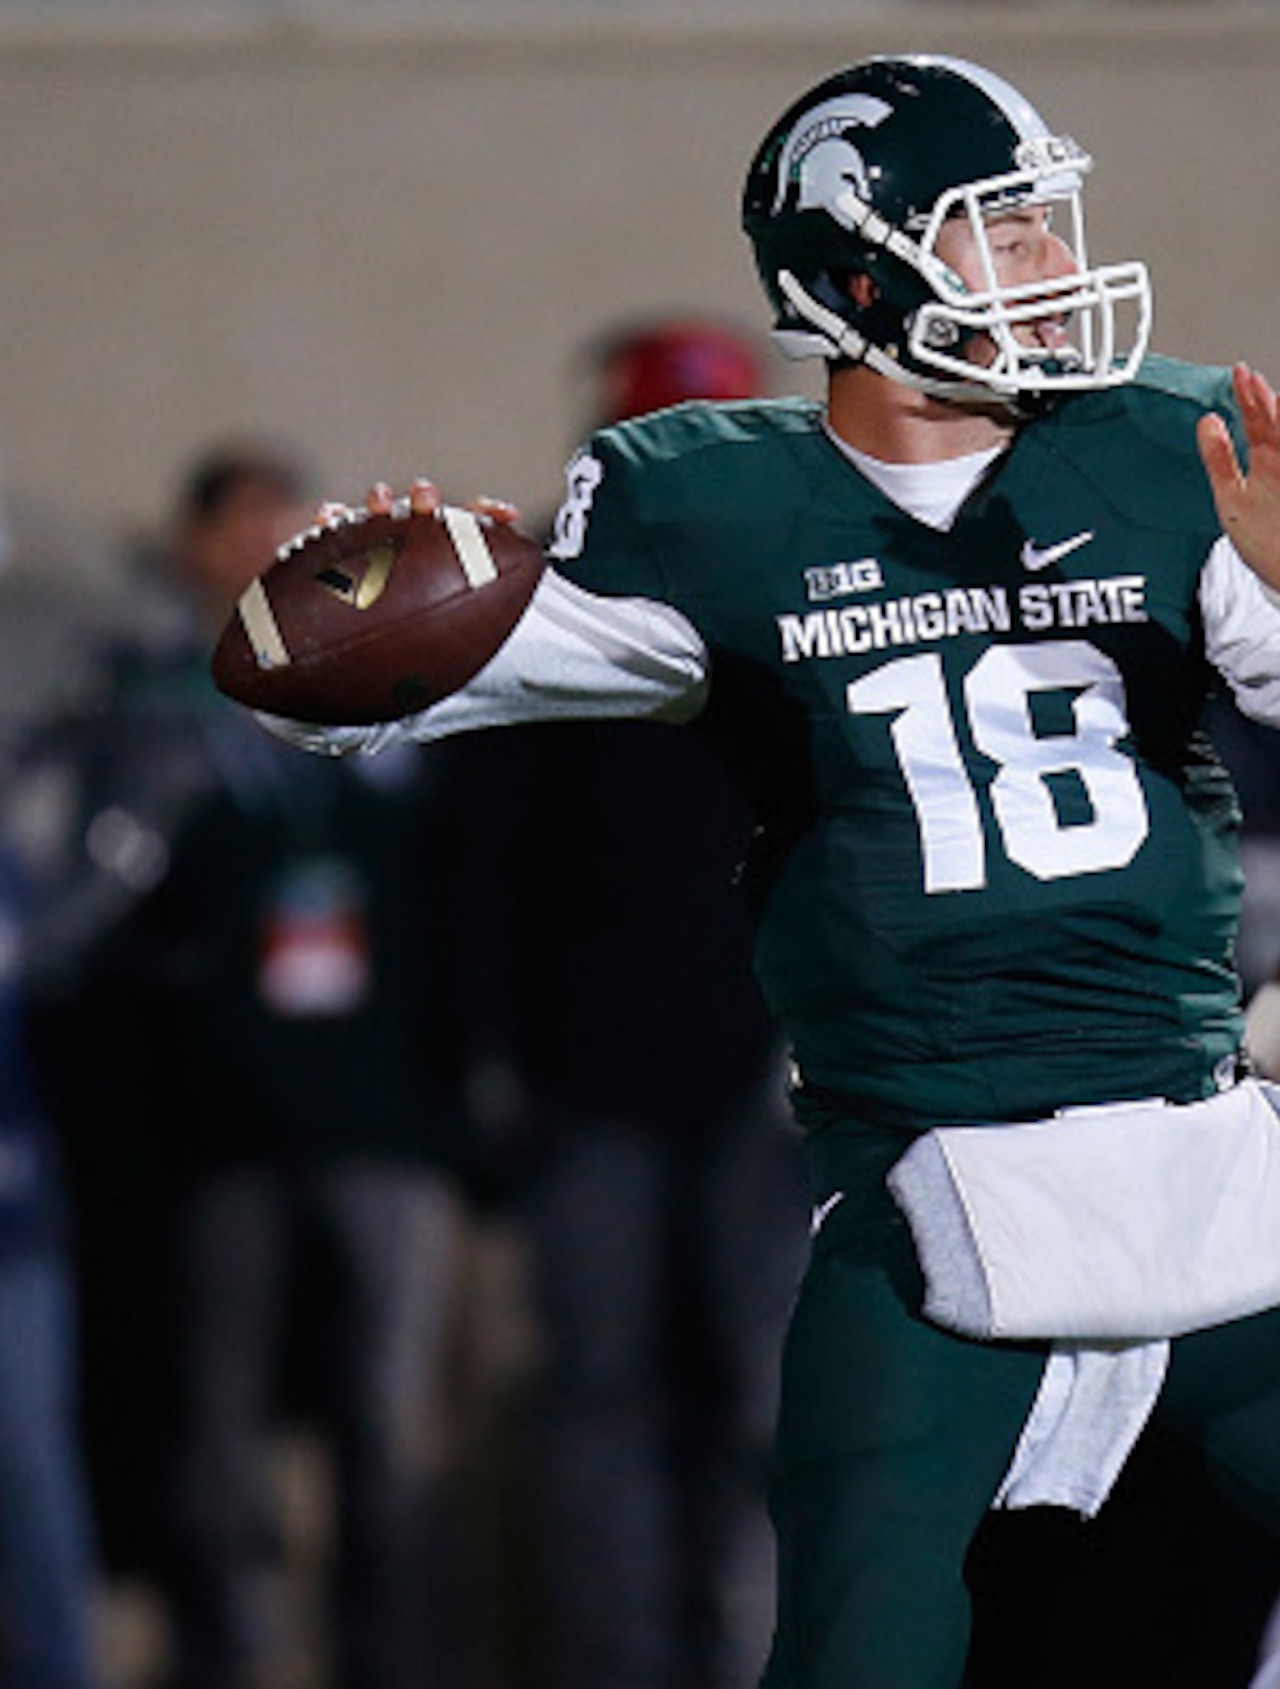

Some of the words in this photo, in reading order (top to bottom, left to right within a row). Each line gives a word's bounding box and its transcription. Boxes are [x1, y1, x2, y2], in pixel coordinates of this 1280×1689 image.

[776, 586, 1011, 662] MICHIGAN
[1019, 575, 1150, 630] STATE
[845, 639, 1150, 895] 18
